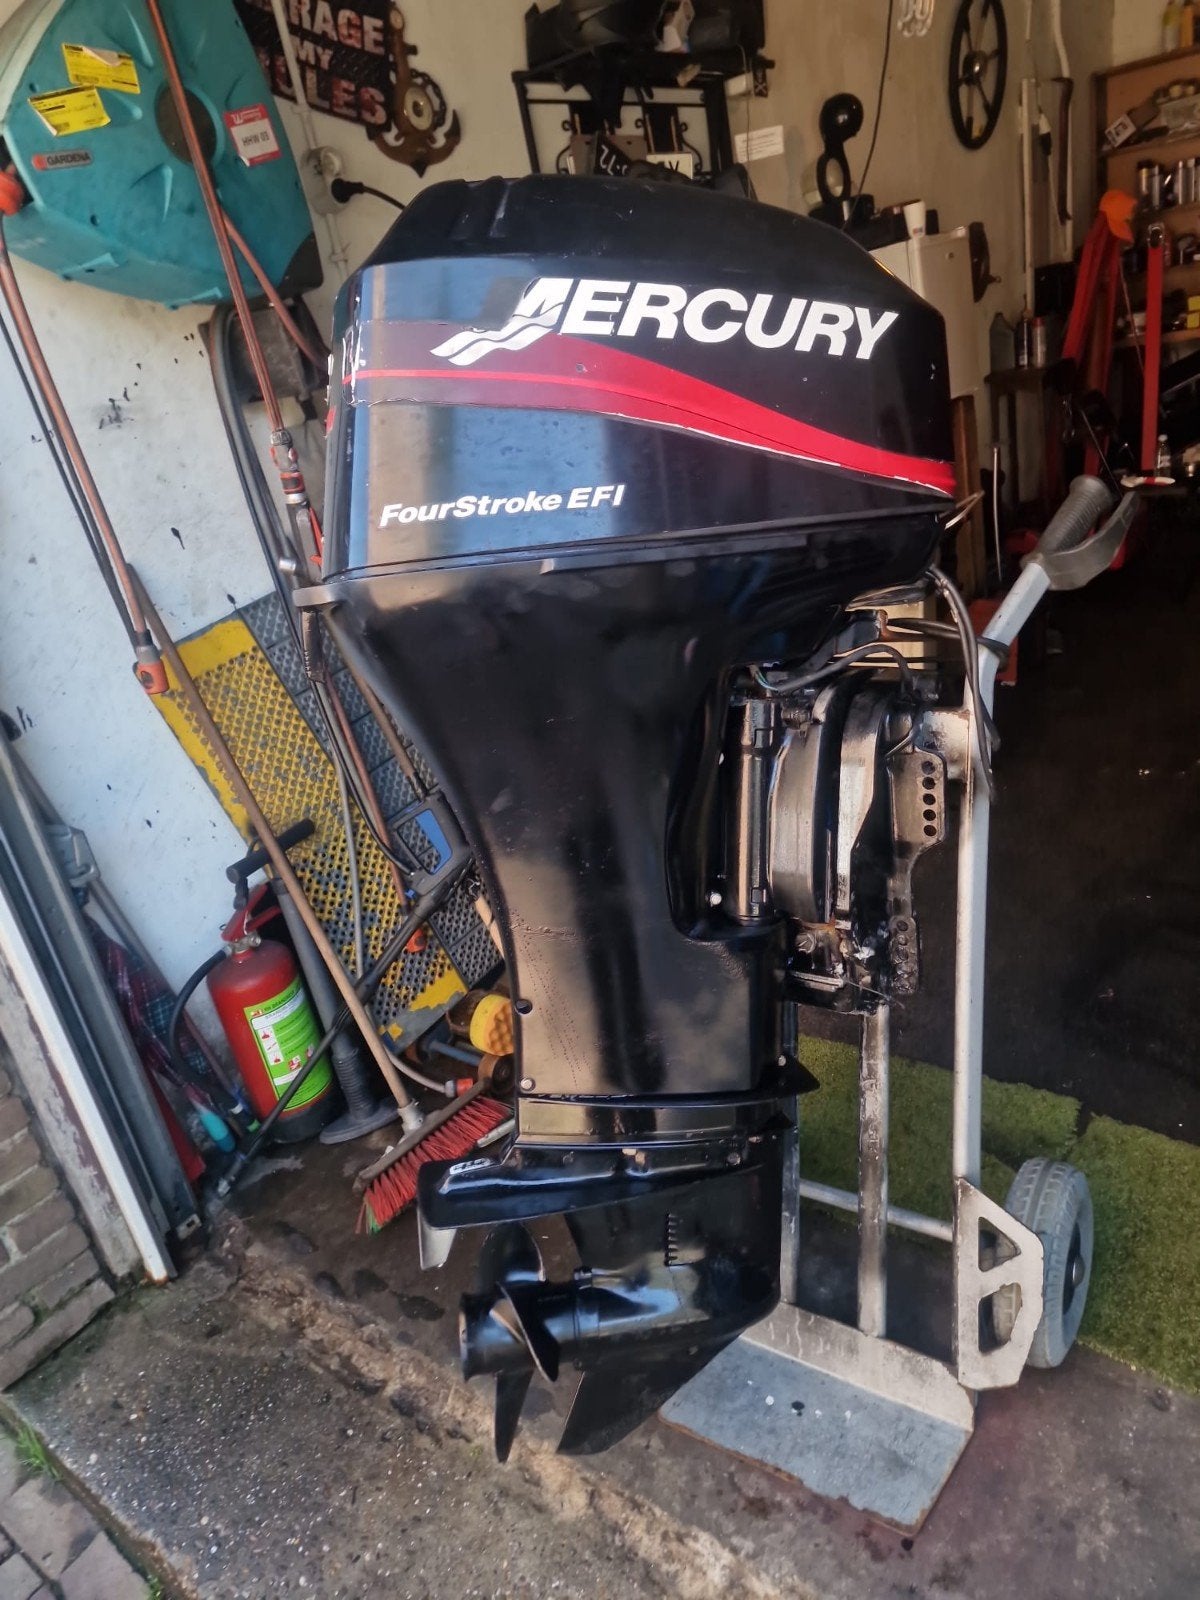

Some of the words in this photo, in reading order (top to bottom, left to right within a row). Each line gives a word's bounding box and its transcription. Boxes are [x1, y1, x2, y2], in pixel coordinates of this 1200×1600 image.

[246, 0, 386, 56] RAGE
[289, 33, 334, 71] MY
[46, 152, 91, 166] GARDENA
[430, 276, 899, 366] MERCURY
[378, 490, 563, 529] FourStroke
[566, 484, 626, 510] EFI
